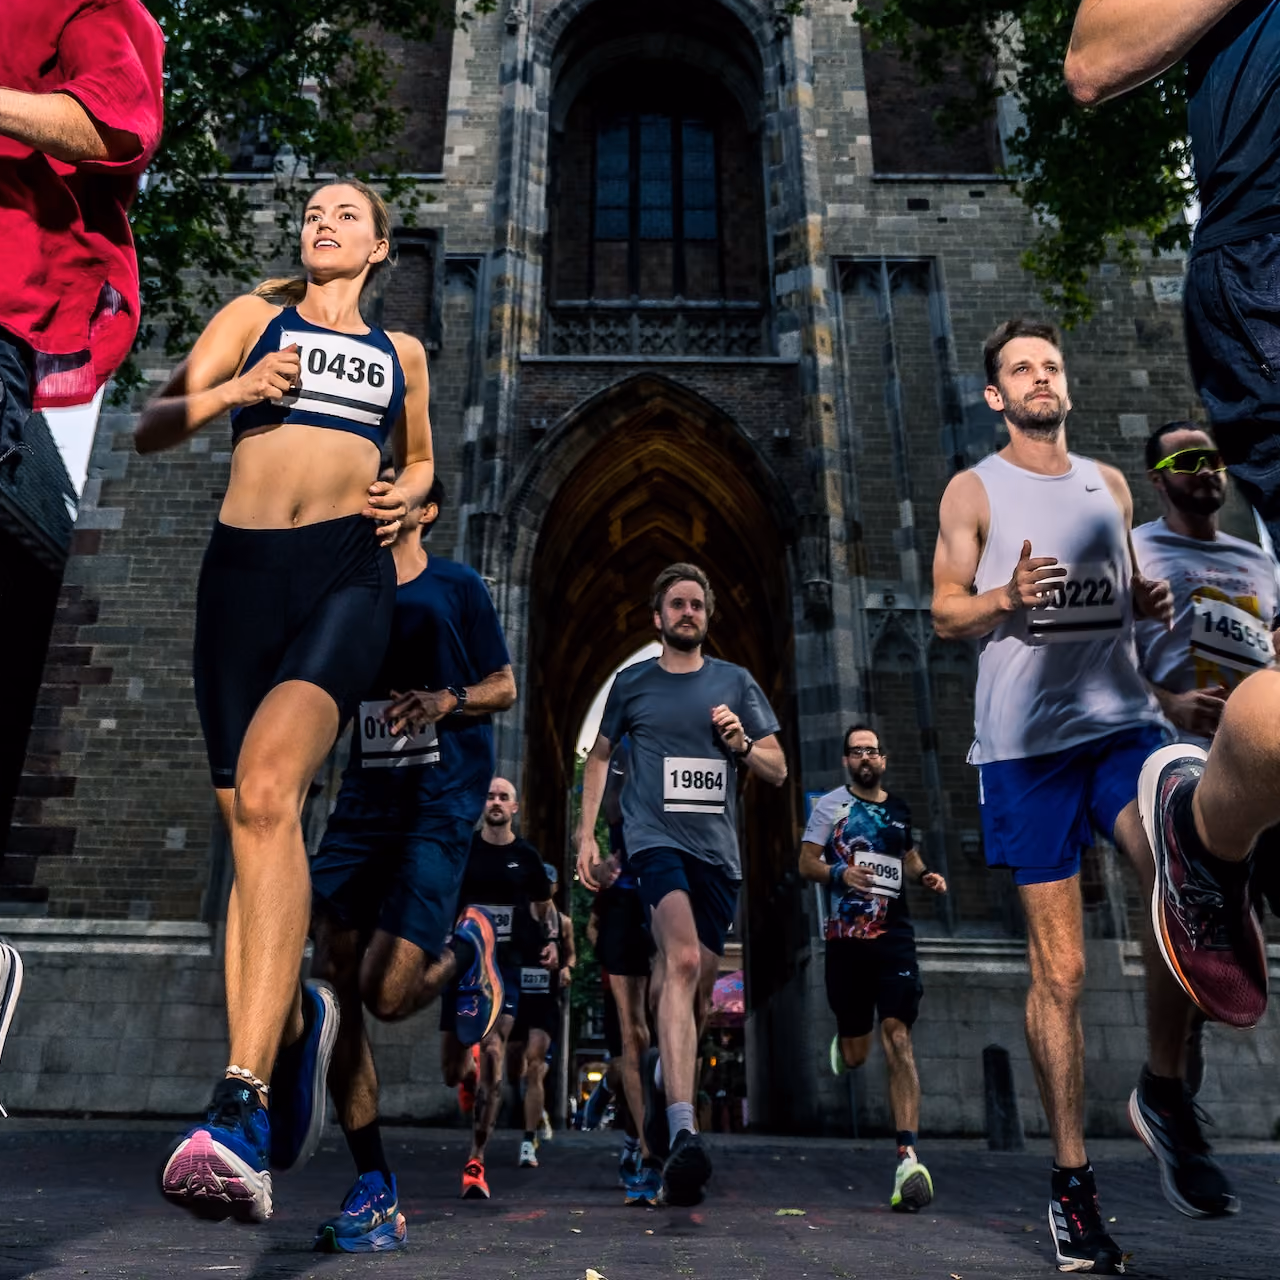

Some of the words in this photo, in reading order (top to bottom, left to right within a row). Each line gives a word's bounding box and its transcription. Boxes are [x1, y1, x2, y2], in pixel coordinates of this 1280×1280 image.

[297, 346, 385, 388] 0436
[670, 770, 723, 791] 19864
[493, 914, 509, 927] 30
